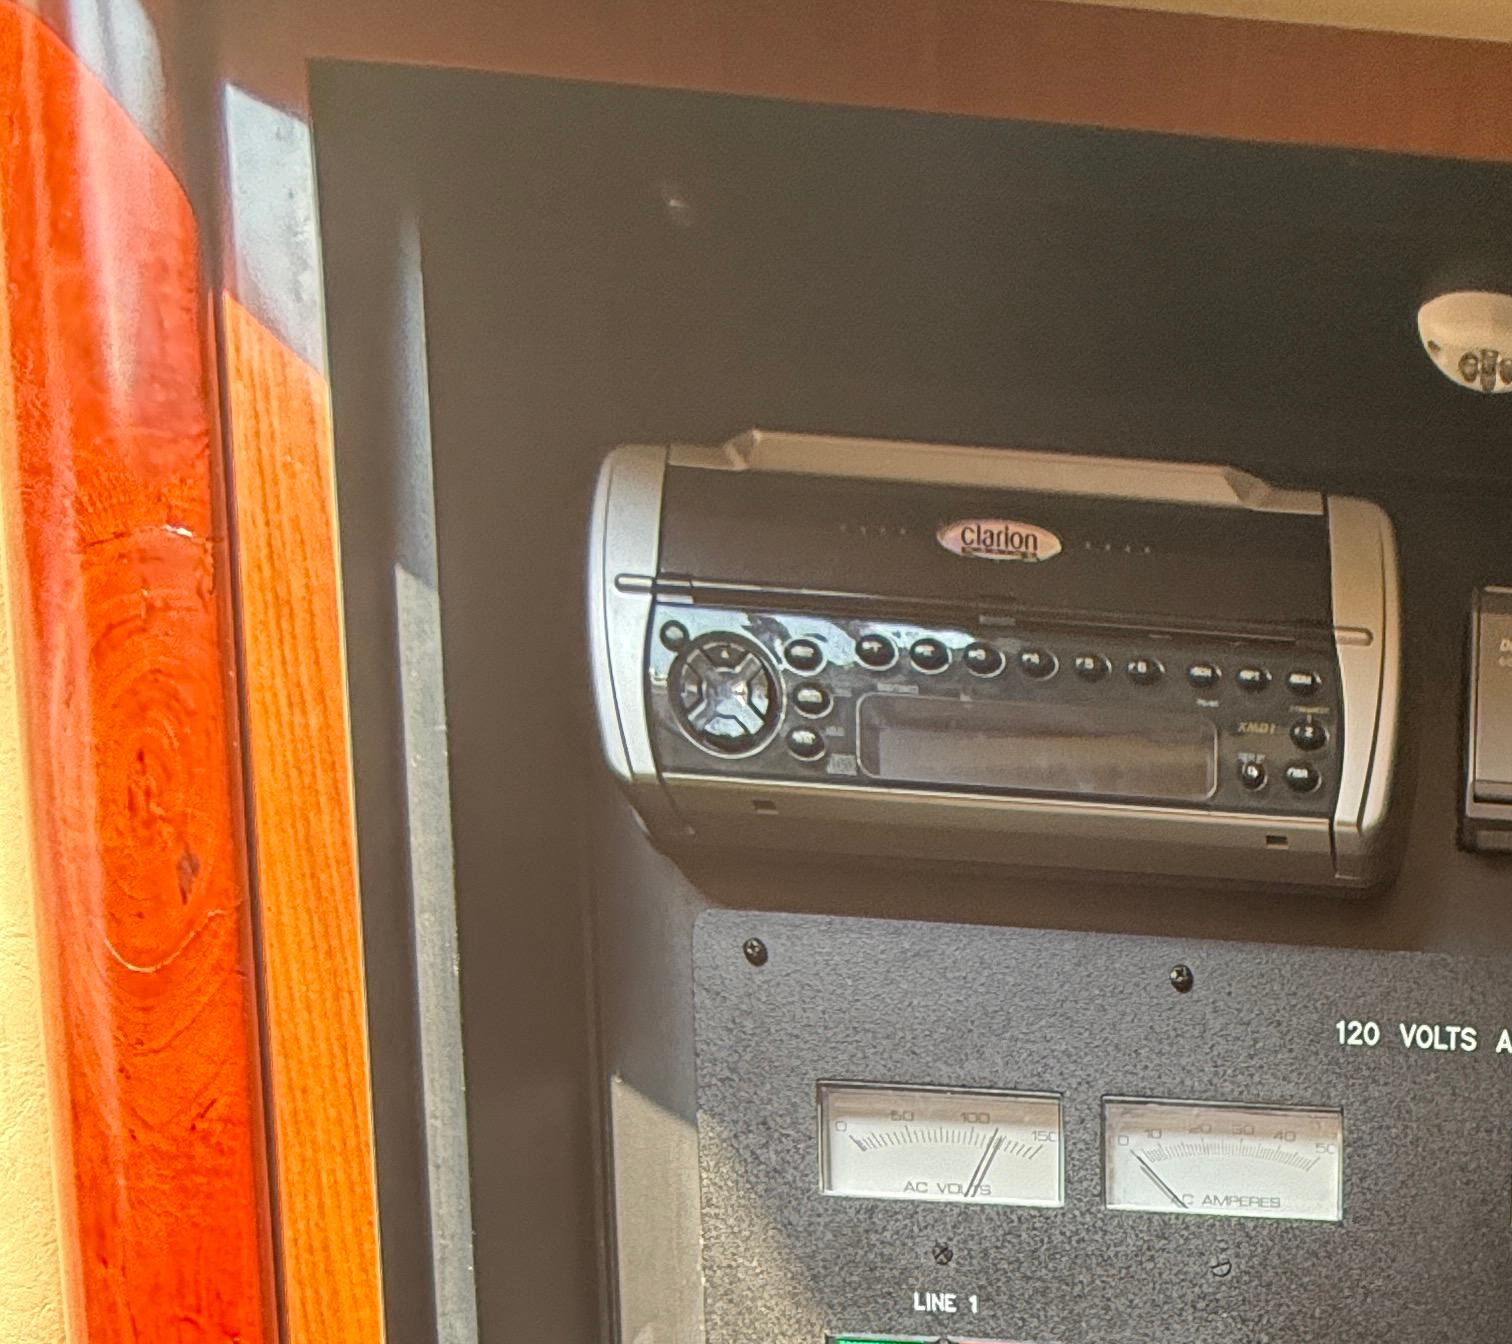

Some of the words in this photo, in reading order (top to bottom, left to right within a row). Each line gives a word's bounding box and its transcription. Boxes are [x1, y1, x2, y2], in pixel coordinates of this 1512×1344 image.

[1336, 1021, 1380, 1045] 120
[1400, 1023, 1477, 1051] VOLTS
[914, 1292, 956, 1312] LINE
[969, 1295, 977, 1314] 1
